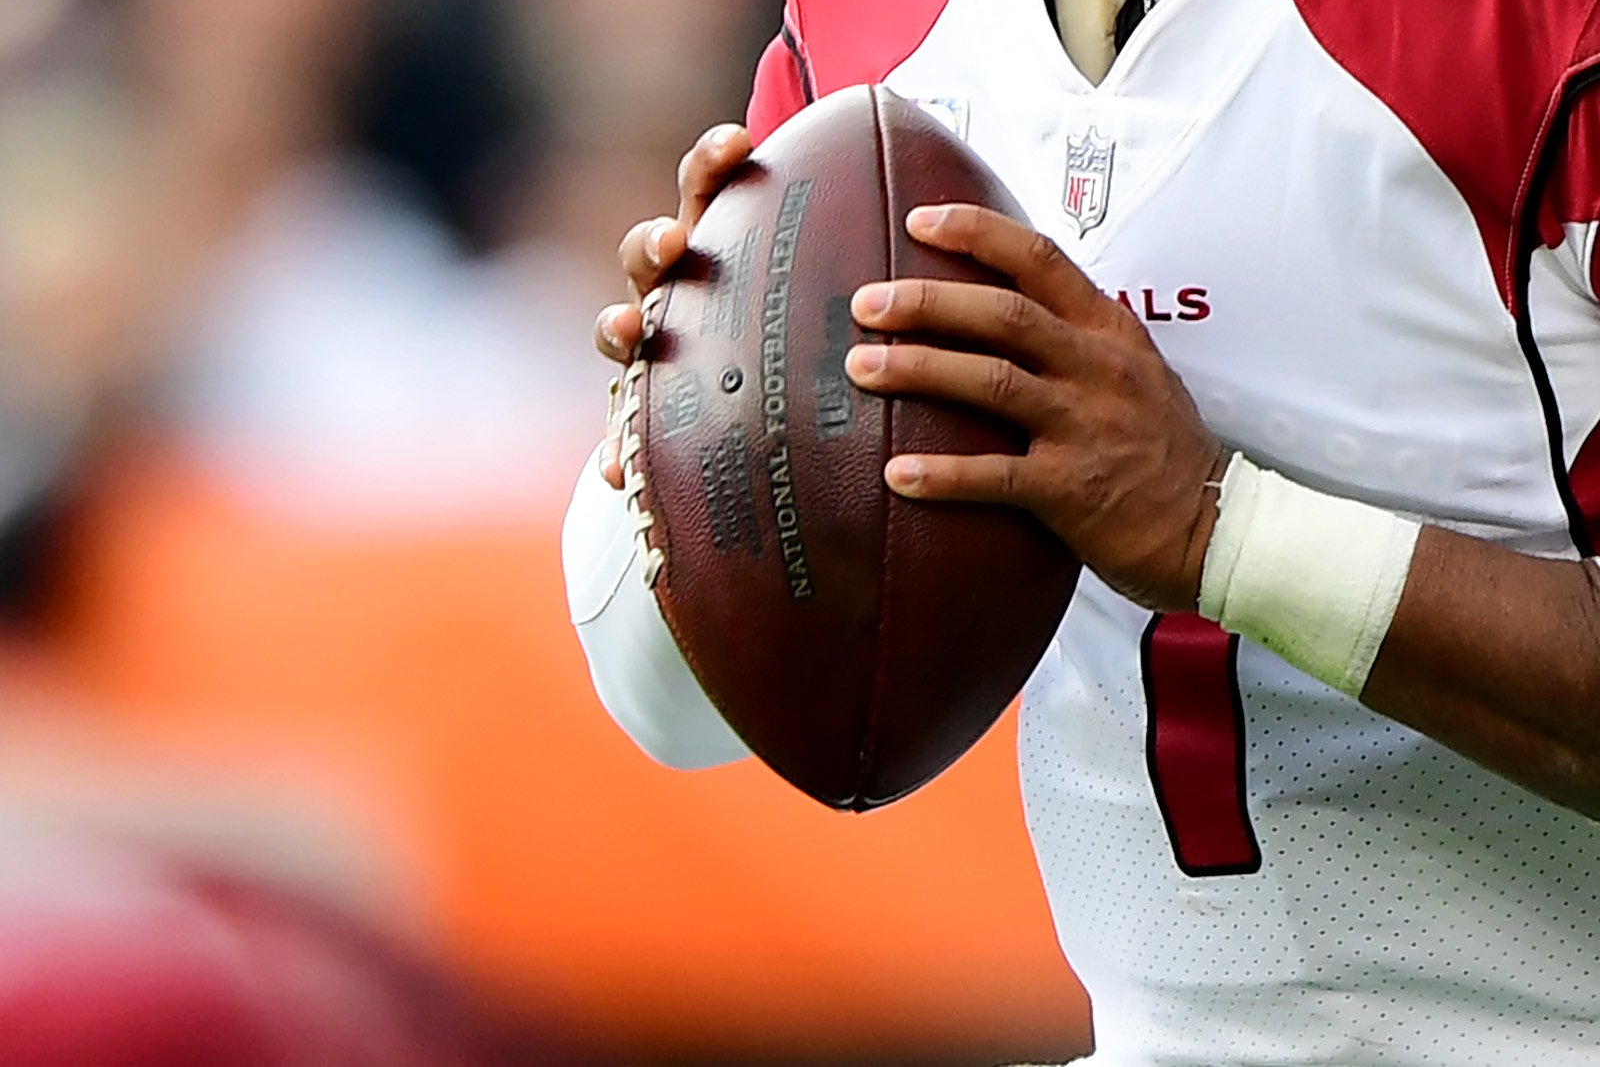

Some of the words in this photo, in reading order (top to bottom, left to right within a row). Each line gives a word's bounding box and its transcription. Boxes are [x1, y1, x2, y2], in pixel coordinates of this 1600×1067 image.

[1067, 175, 1097, 218] NFL
[763, 281, 789, 435] FOOTBALL
[769, 445, 812, 599] NATIONAL
